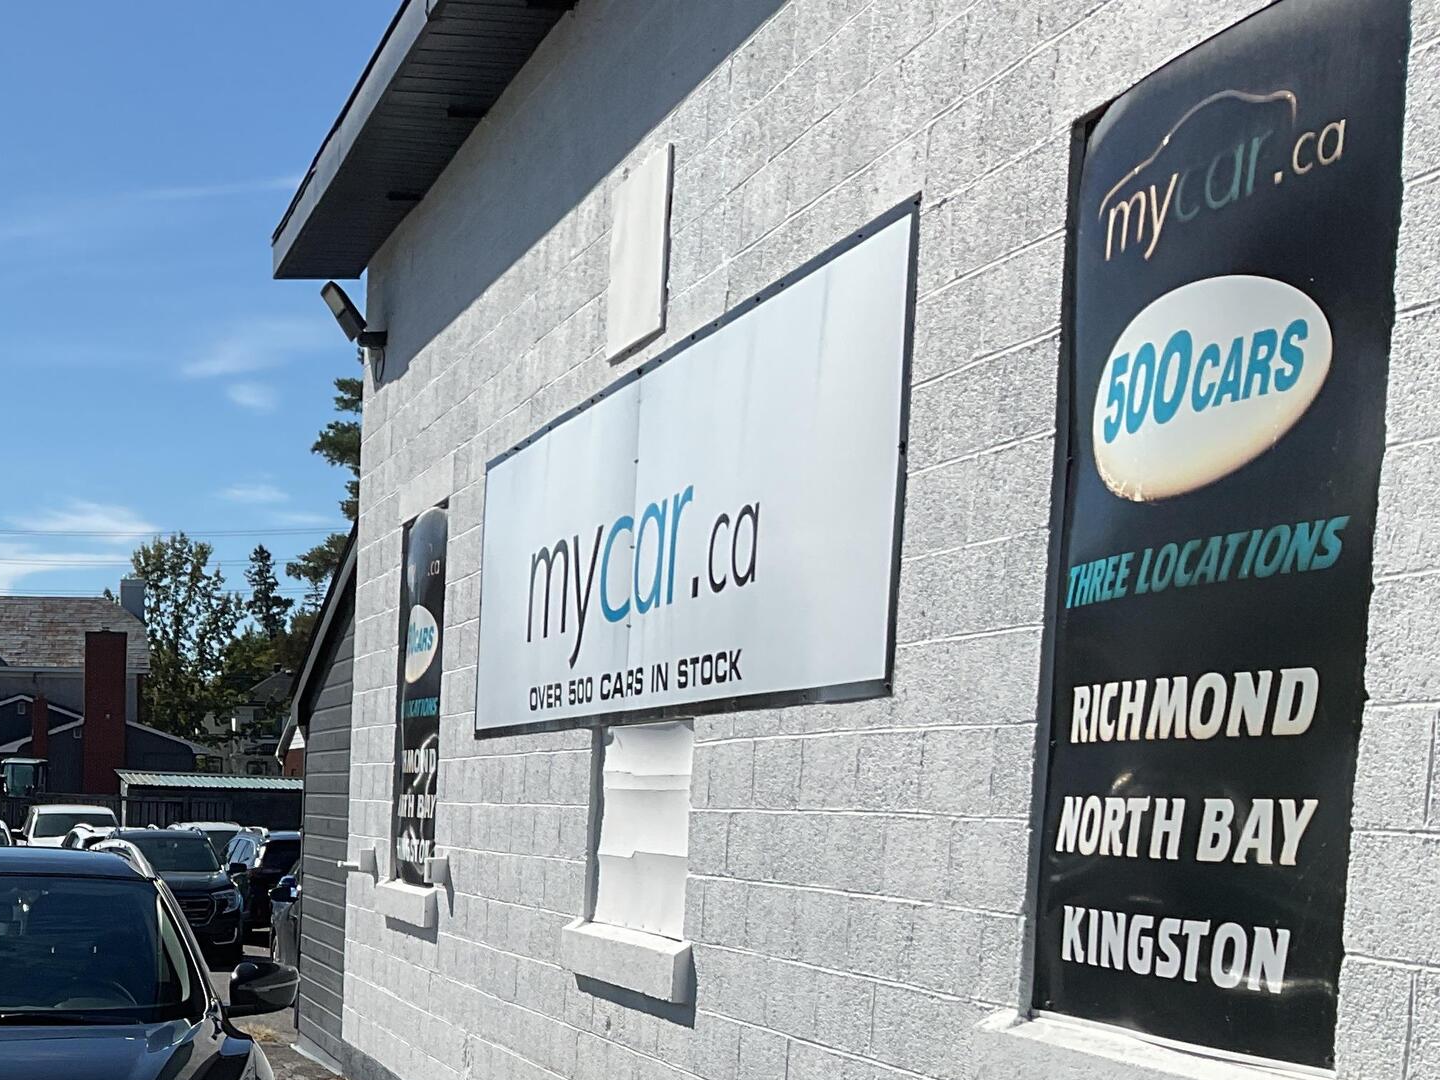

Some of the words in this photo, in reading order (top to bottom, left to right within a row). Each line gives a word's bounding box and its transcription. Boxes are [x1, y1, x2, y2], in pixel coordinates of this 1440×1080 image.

[1106, 119, 1346, 261] mycar.ca
[527, 485, 760, 668] mycar.ca
[1066, 553, 1130, 608] THREE
[1135, 516, 1351, 594] LOCATIONS
[530, 684, 562, 711] OVER
[568, 678, 594, 705] 500
[599, 668, 643, 701] CARS
[649, 662, 669, 693] IN
[677, 649, 743, 689] STOCK
[1071, 668, 1319, 743] RICHMOND
[1056, 795, 1186, 860] NORTH
[1197, 799, 1318, 865] BAY
[1062, 906, 1291, 994] KINGSTON
